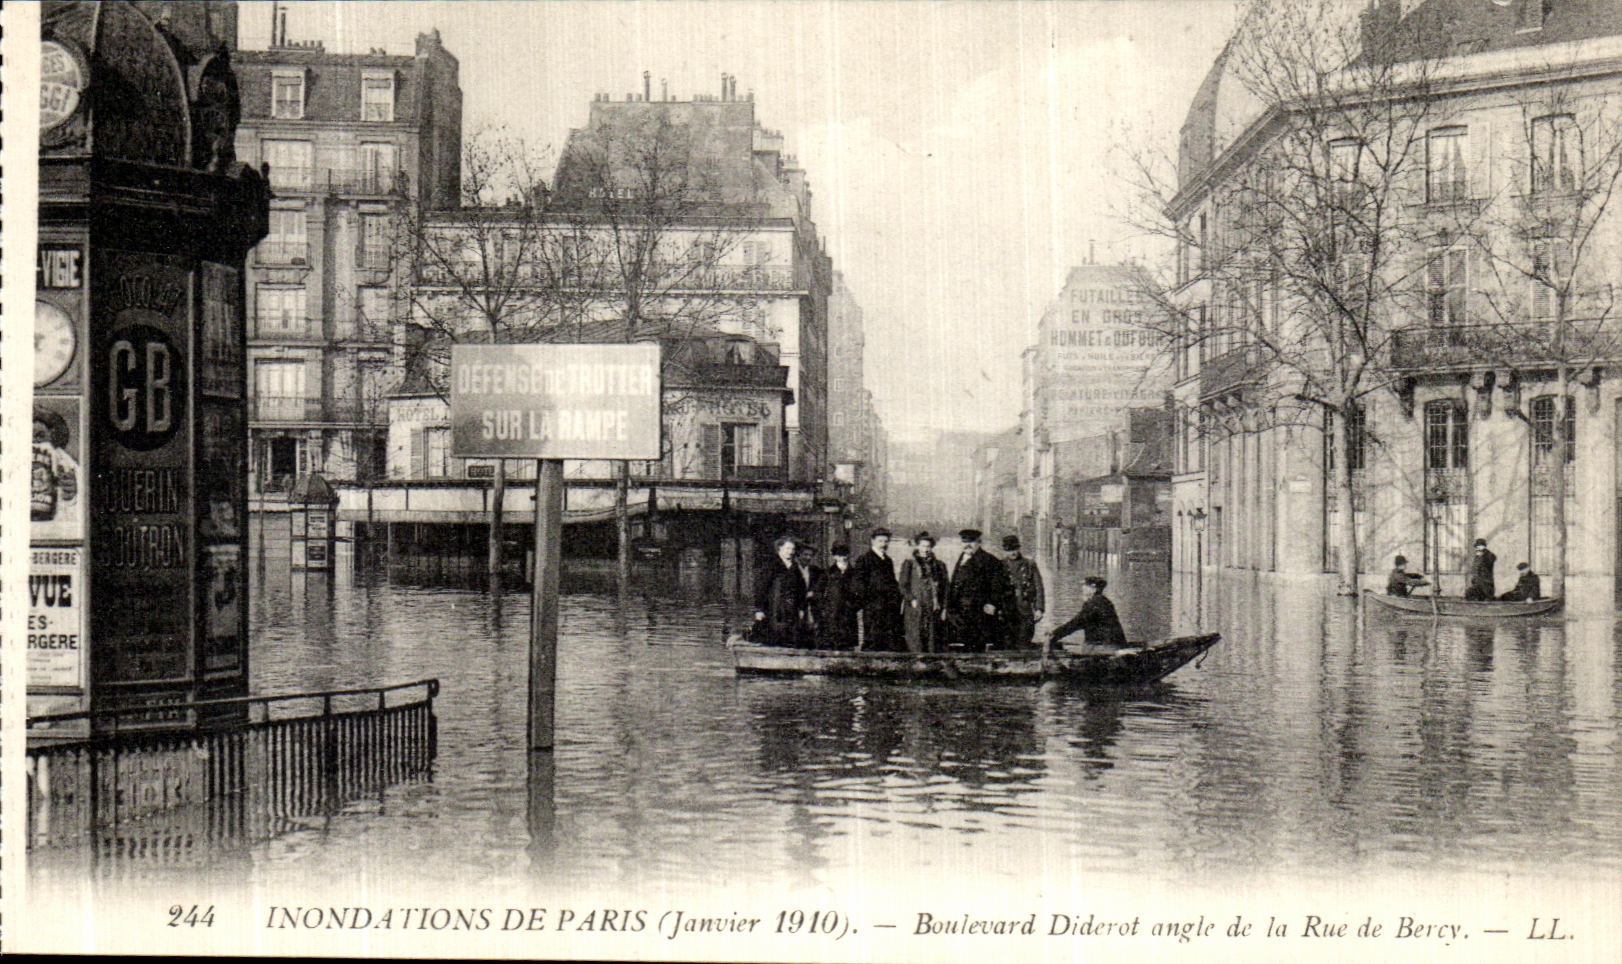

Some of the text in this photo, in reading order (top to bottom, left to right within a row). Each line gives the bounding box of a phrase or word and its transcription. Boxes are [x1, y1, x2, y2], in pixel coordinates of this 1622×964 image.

[1071, 309, 1090, 323] EN
[109, 340, 172, 432] GB
[482, 410, 628, 441] SUR LA RAMPE
[28, 575, 72, 607] VUE
